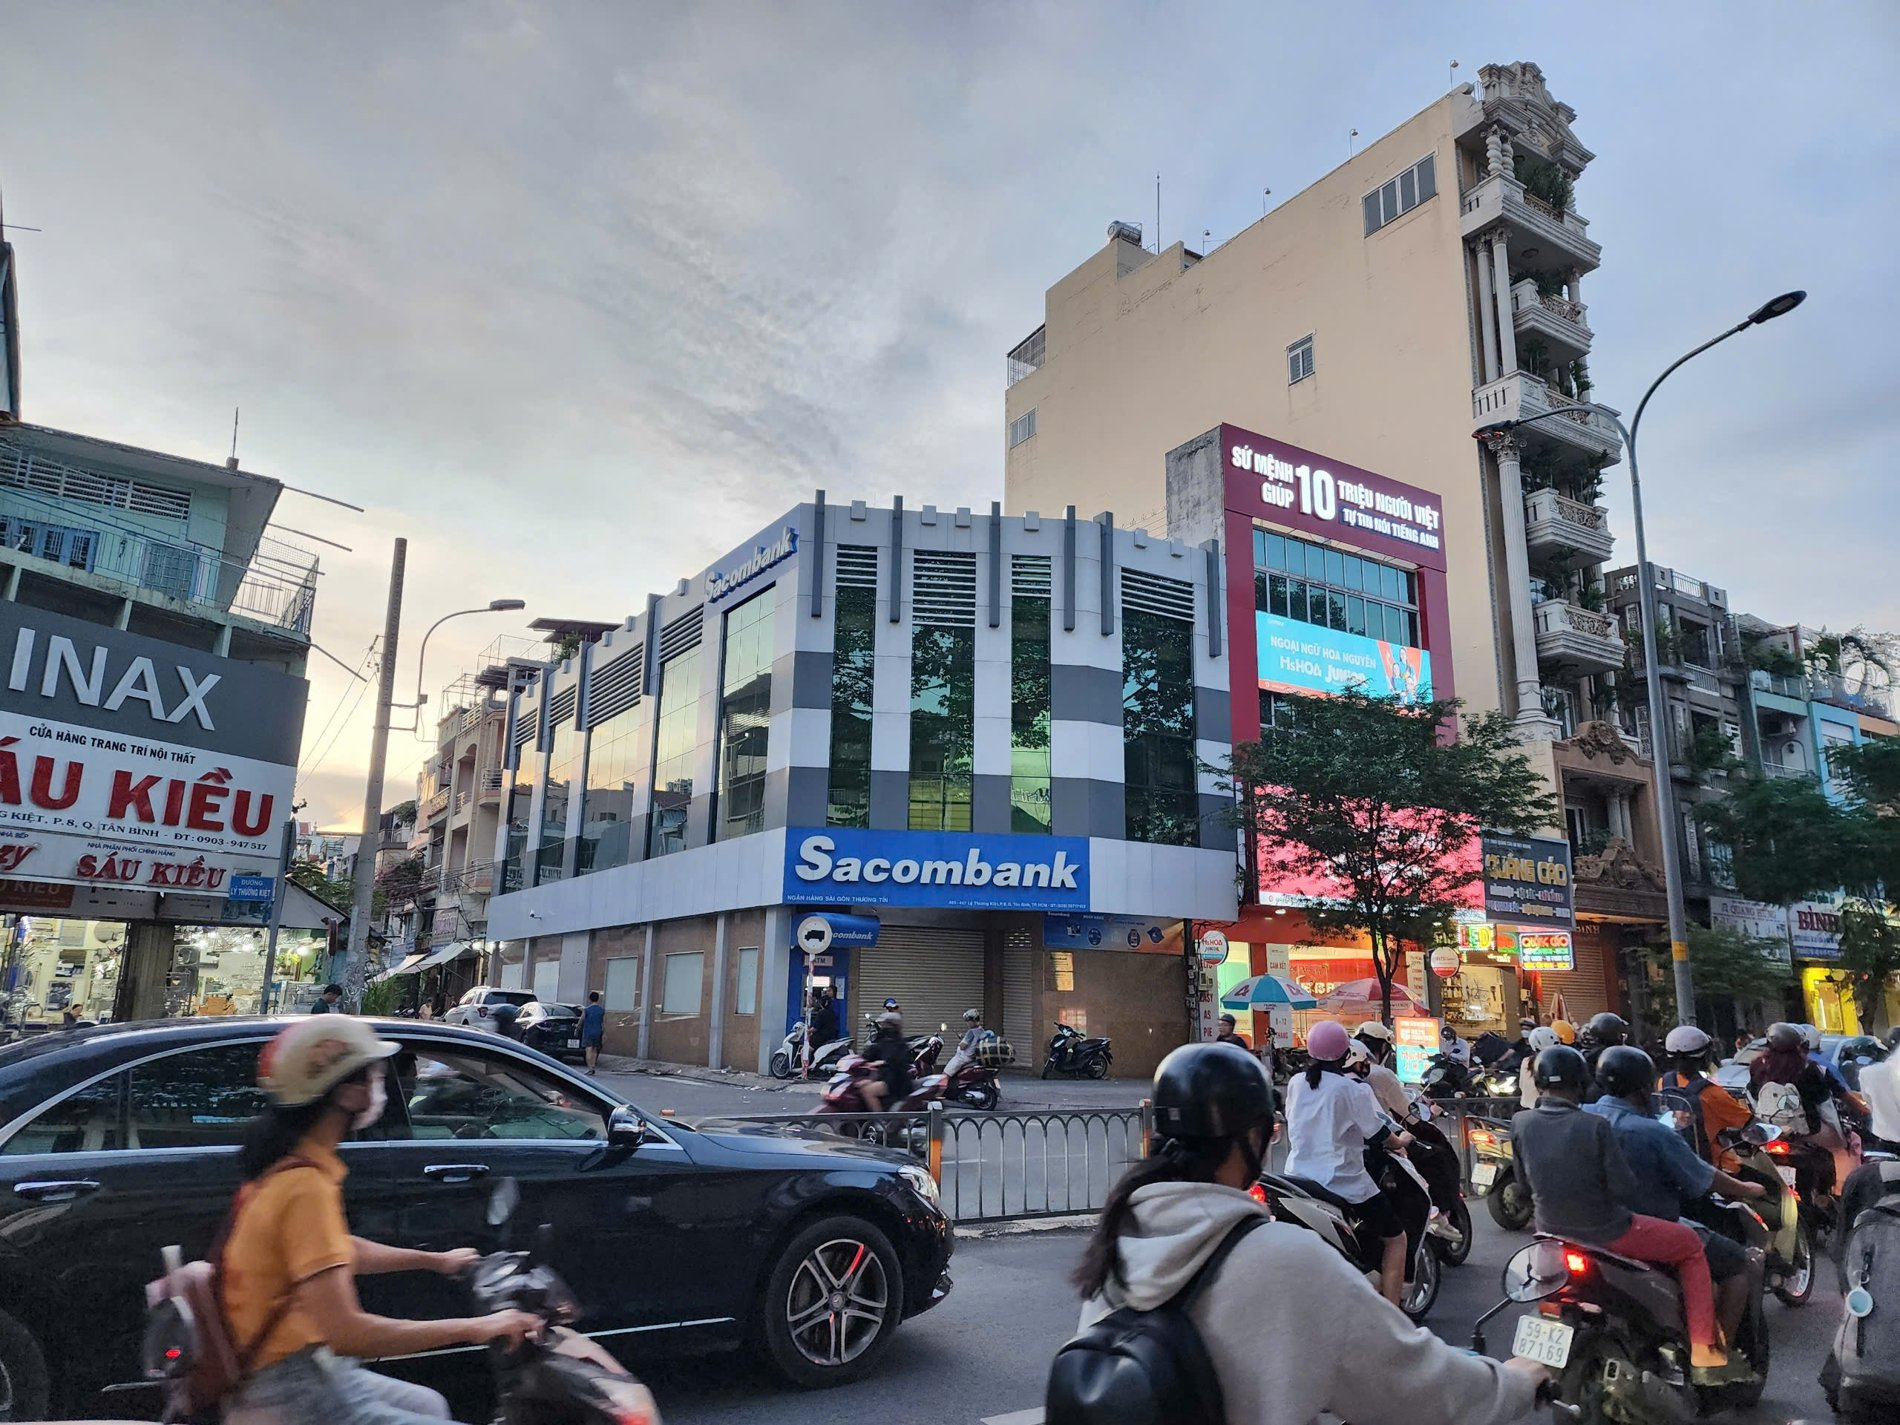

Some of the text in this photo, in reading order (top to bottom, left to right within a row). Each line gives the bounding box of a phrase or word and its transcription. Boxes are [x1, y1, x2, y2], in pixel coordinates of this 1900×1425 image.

[1232, 445, 1293, 483] SỨ MỆNH
[1262, 482, 1294, 508] GIÚP
[1295, 465, 1336, 520] 10
[1337, 480, 1439, 530] TRIỆU NGƯỜI VIỆT
[1357, 512, 1373, 529] TIN
[1391, 523, 1419, 543] TIẾNG
[1419, 532, 1439, 549] ANH
[704, 526, 799, 603] Sacombank
[1322, 647, 1341, 661] HOA
[8, 627, 222, 732] INAX
[29, 723, 196, 765] CỬA HÀNG TRANG TRÍ NỘI THẤT
[107, 767, 274, 837] KIỀU
[100, 823, 125, 833] TÂN
[129, 826, 159, 837] BÌNH
[76, 851, 227, 888] SÁU KIỀU
[795, 835, 1081, 889] Sacombank
[1537, 856, 1568, 887] CÁO
[832, 931, 873, 940] combank
[1460, 926, 1492, 948] LED
